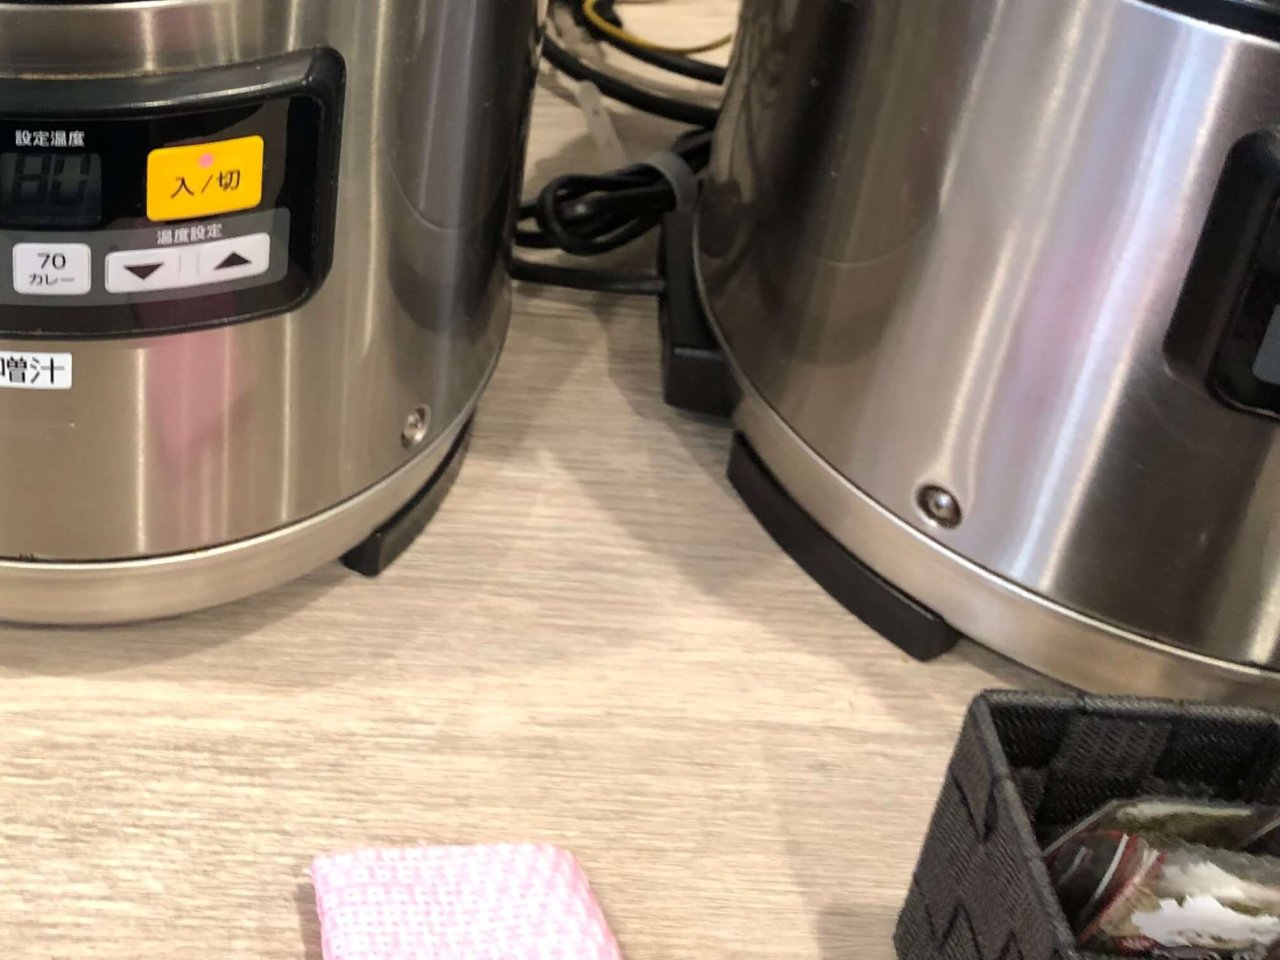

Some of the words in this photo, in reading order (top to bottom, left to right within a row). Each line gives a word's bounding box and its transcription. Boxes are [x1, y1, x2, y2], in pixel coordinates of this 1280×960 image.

[15, 129, 85, 147] 設定温度
[156, 223, 223, 244] 温度設定
[37, 252, 67, 271] 70
[28, 272, 76, 286] カレー
